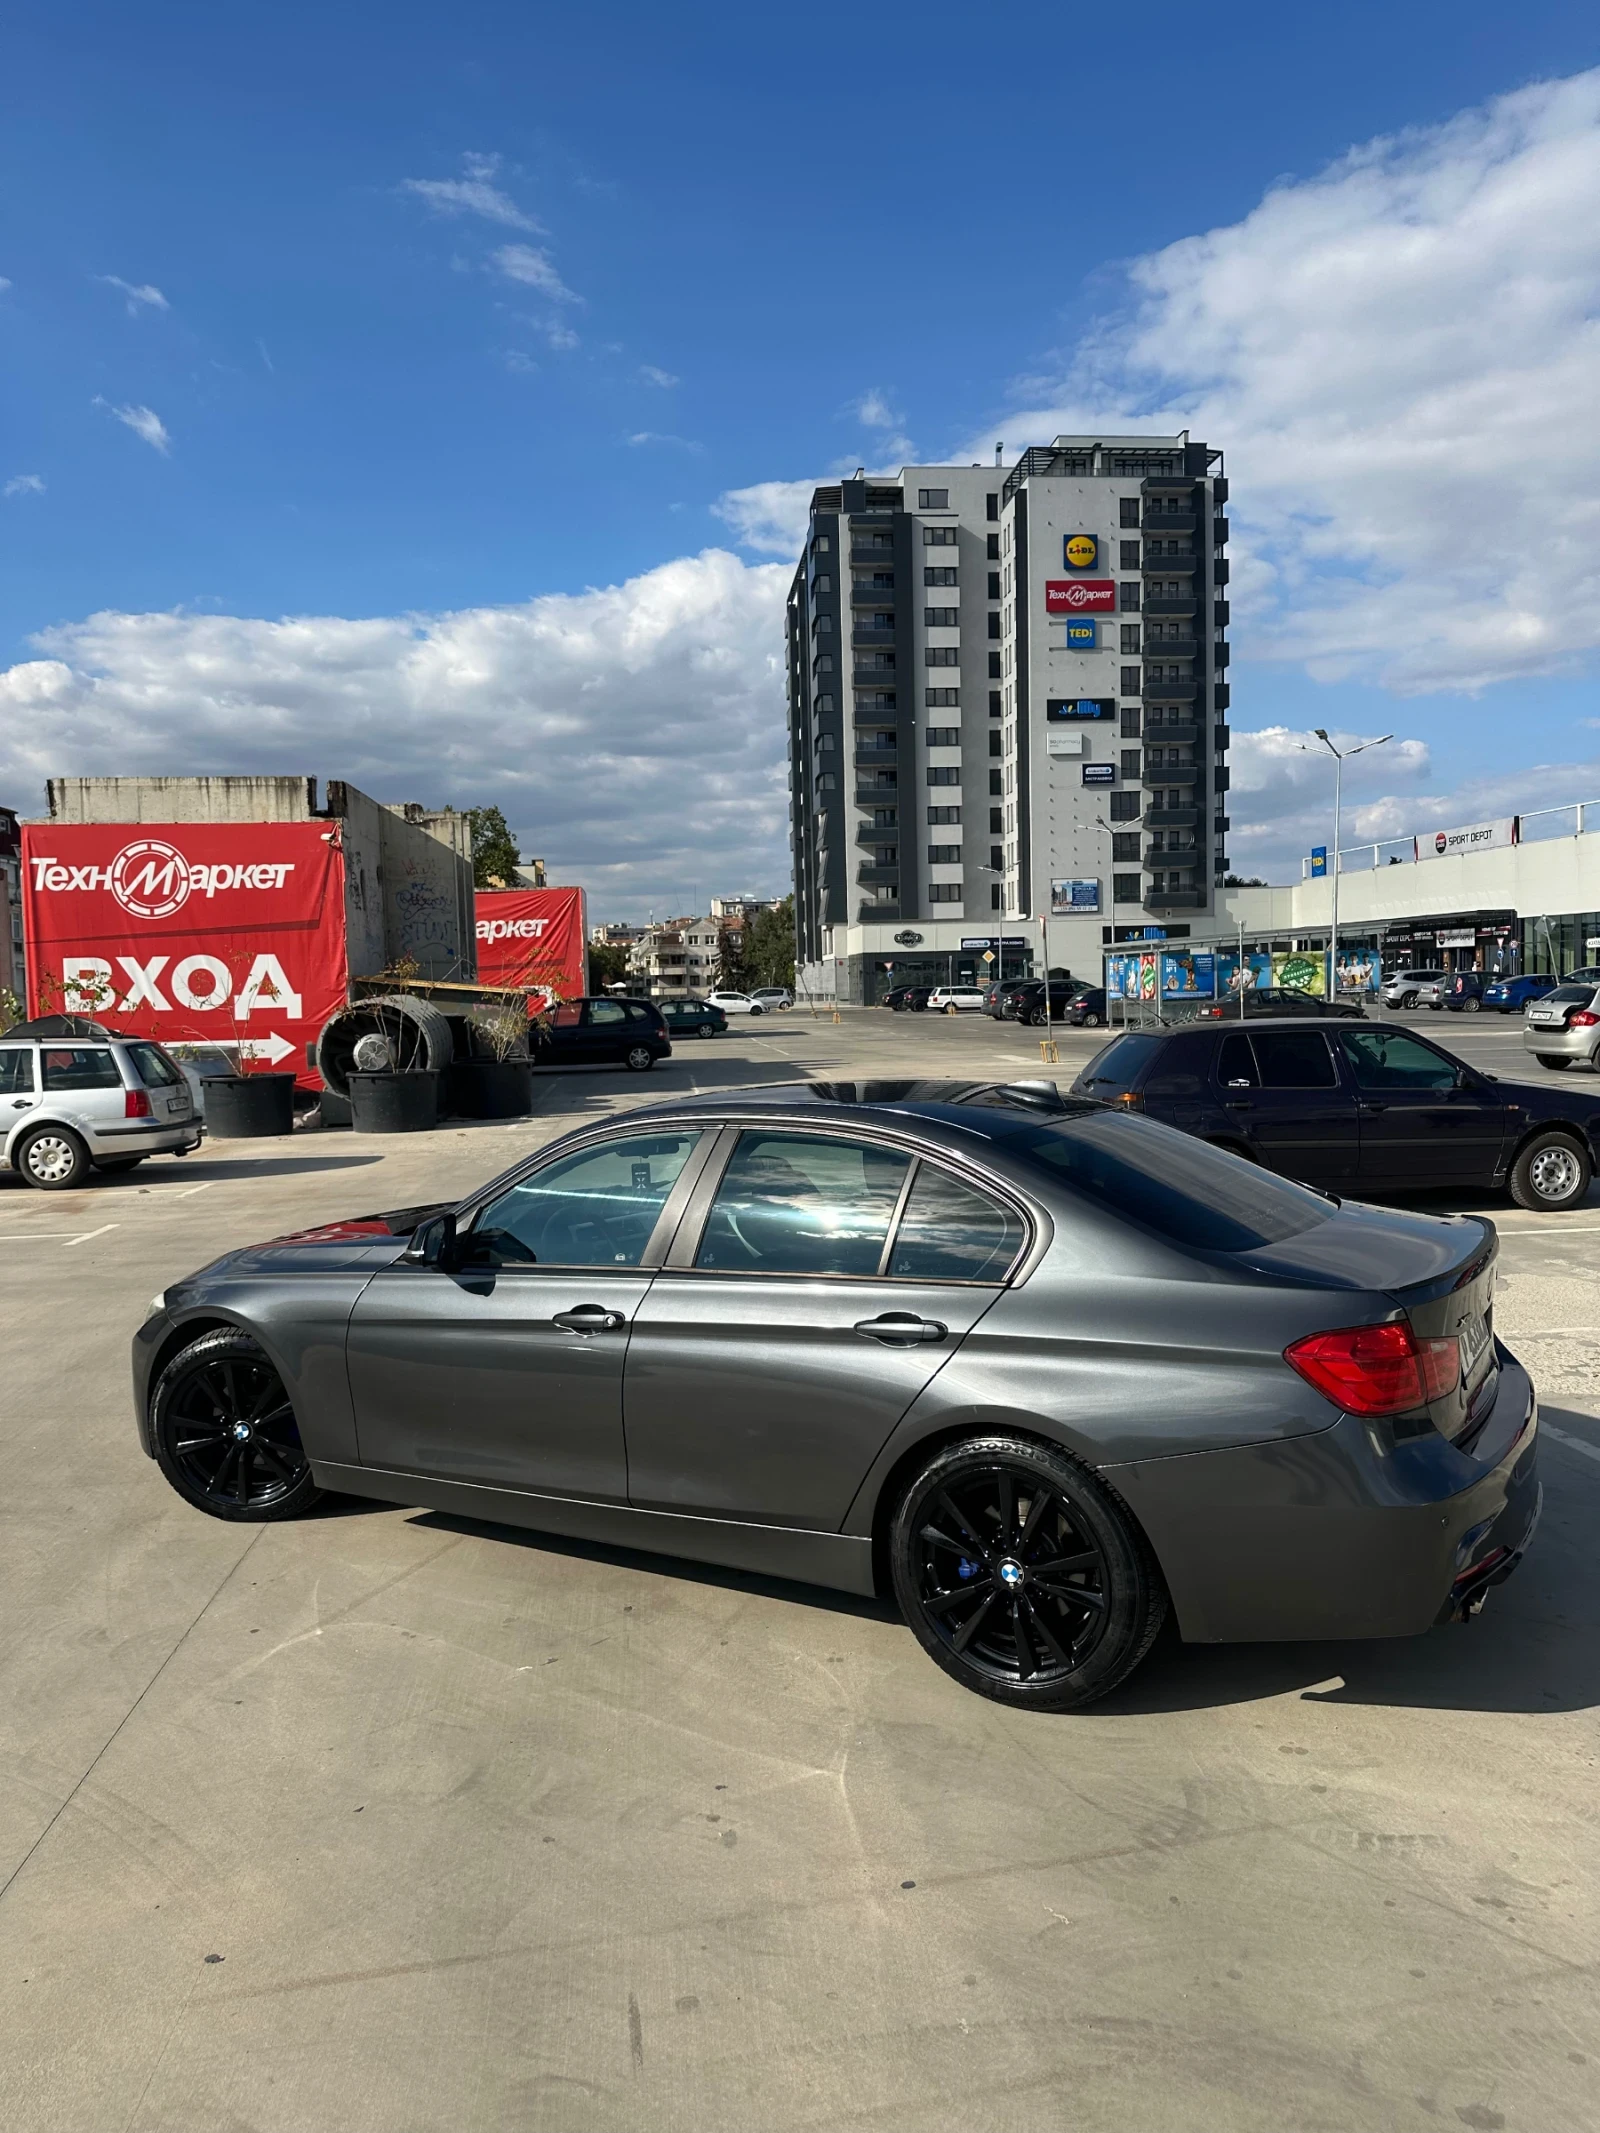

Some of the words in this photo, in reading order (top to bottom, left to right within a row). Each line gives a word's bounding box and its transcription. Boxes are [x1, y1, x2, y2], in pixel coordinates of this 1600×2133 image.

[1069, 628, 1092, 638] TEDi
[1448, 833, 1470, 847] SPORT
[1470, 829, 1493, 843] DEPOT
[62, 953, 302, 1021] ВХОД
